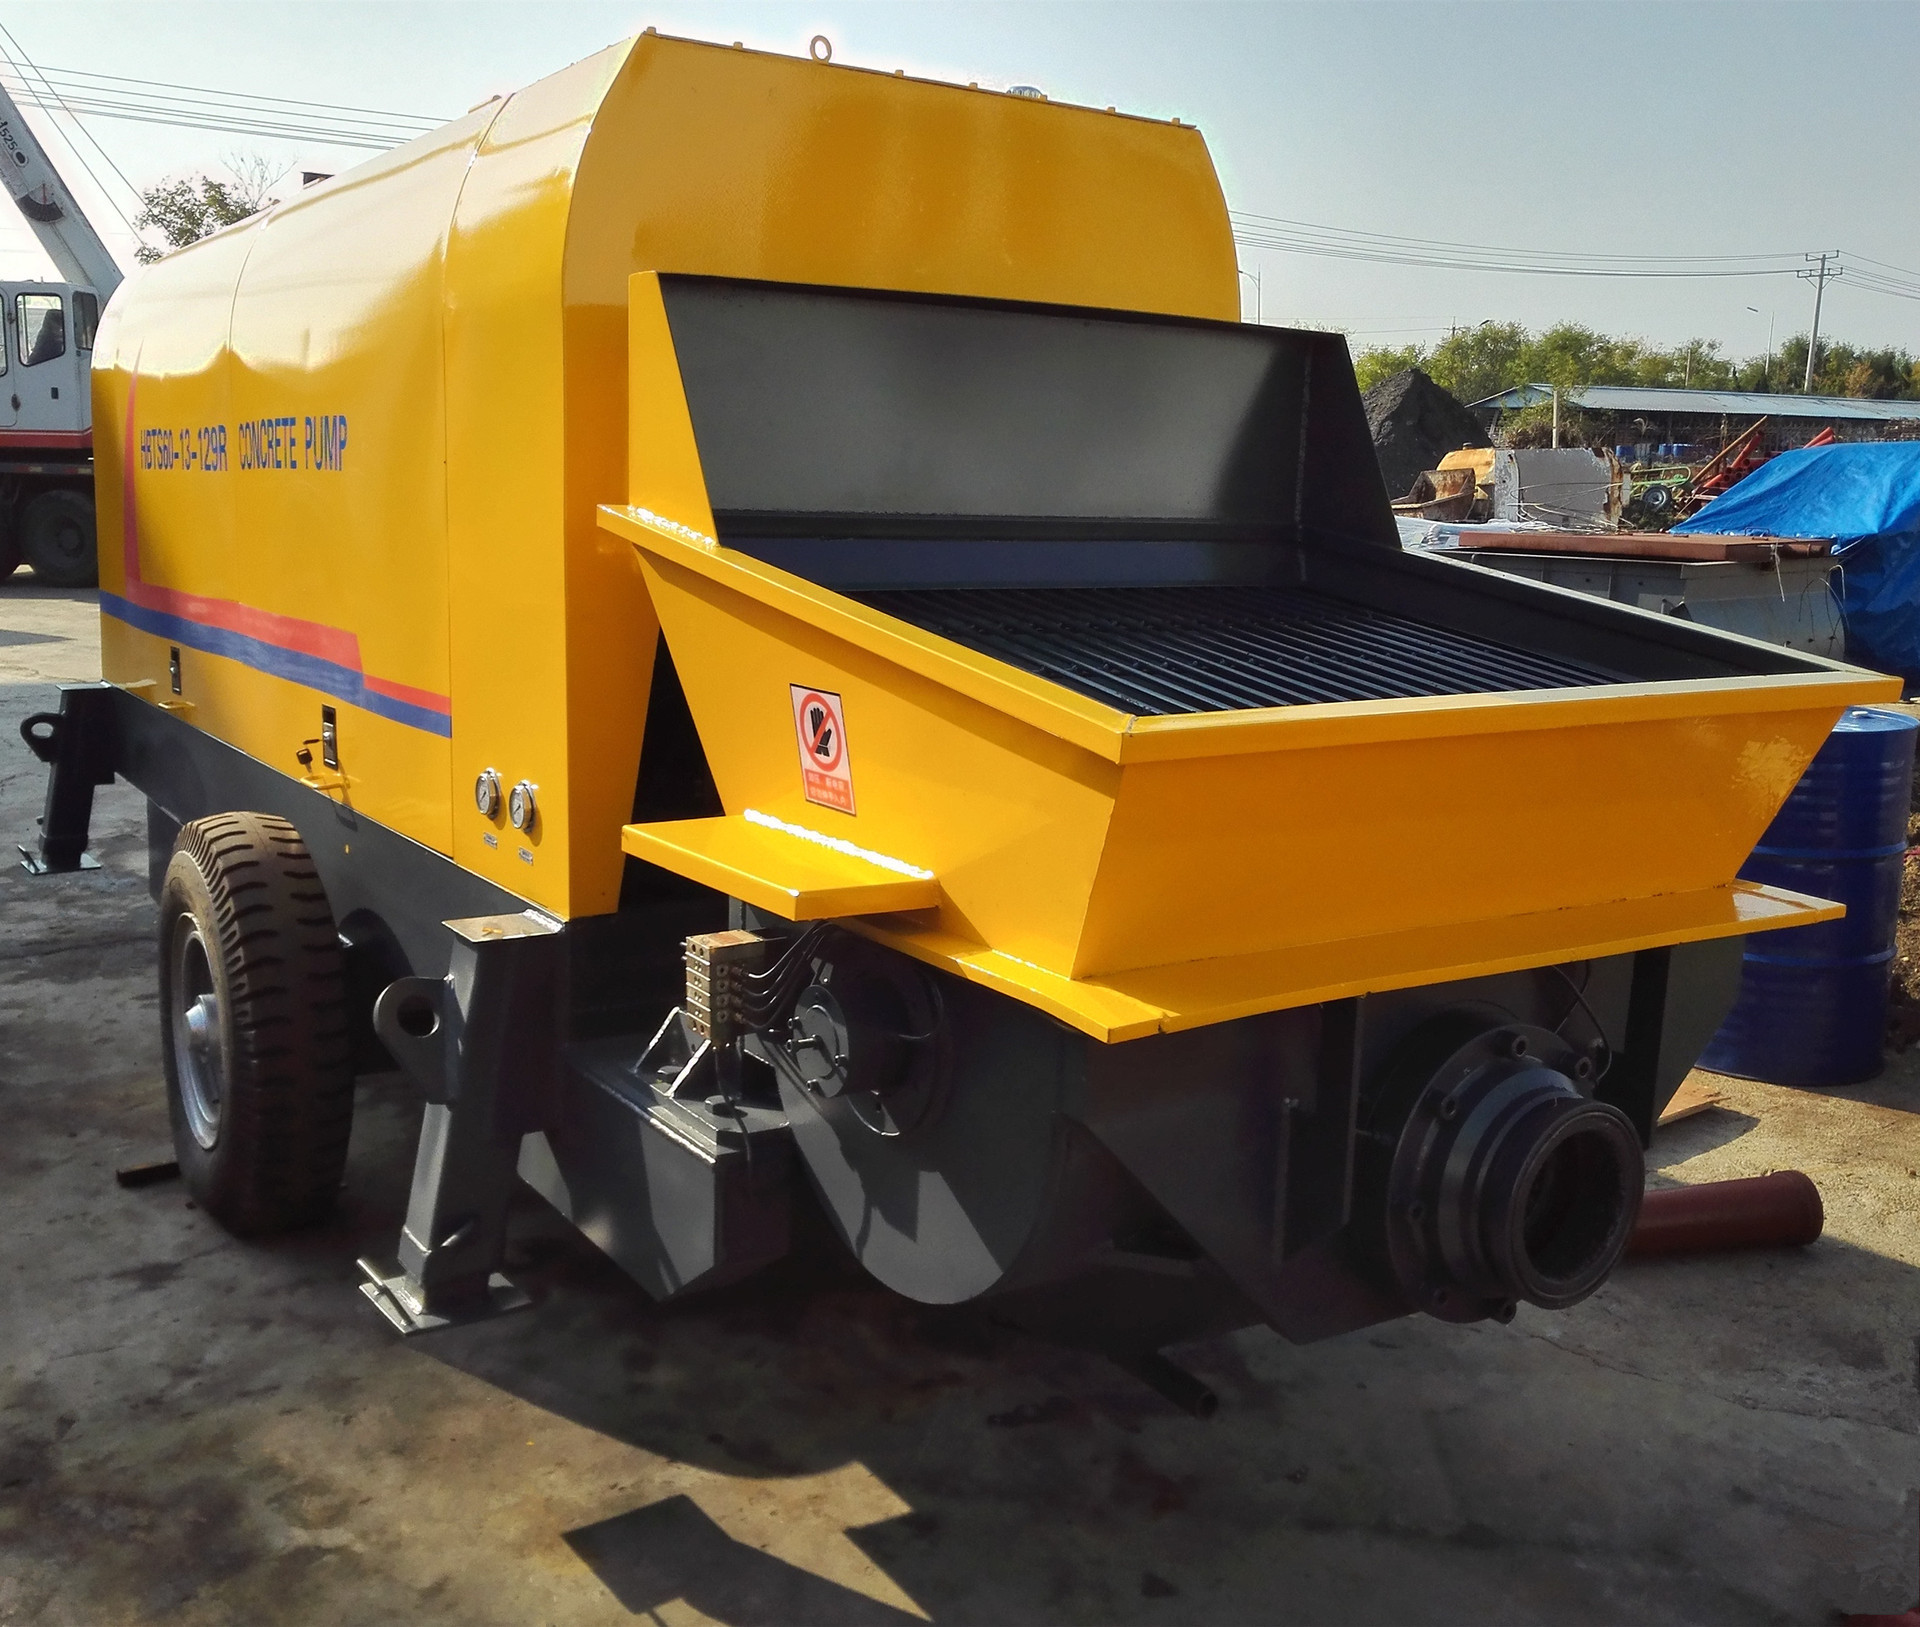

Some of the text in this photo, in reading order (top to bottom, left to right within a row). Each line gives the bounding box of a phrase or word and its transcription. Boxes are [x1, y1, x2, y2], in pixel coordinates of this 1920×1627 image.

[140, 414, 347, 472] HBTS60-13-129R CONCRETE PUMP
